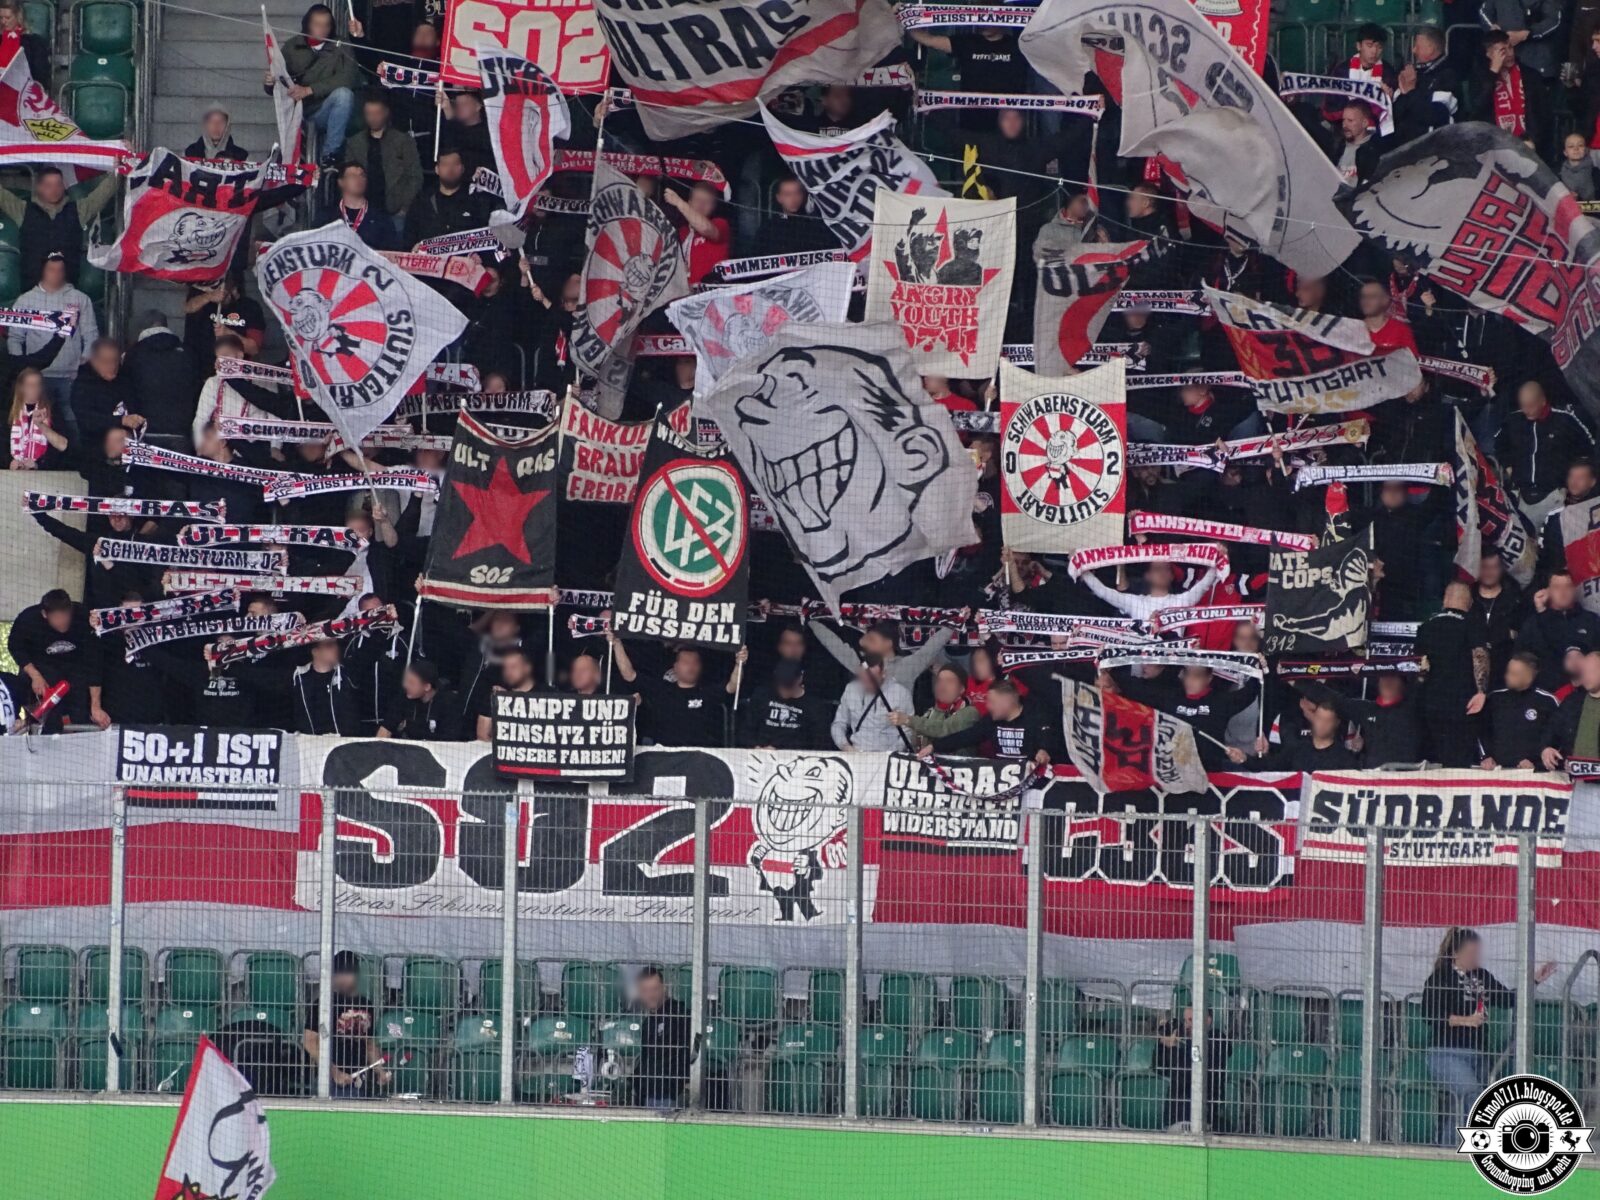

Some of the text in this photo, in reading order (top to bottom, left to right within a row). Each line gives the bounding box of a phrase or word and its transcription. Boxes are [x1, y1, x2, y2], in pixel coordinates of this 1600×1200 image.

[1007, 395, 1119, 445] SCHWABENSTURM
[1106, 450, 1120, 476] 2
[304, 480, 347, 492] HEISST
[1015, 488, 1110, 524] STUTTGART
[1133, 515, 1243, 538] CANNSTATTER
[100, 539, 250, 567] SCHWABENSTURM
[1071, 544, 1170, 570] CANNSTATTER
[1282, 566, 1334, 590] COPS
[628, 589, 678, 620] FÜR
[686, 601, 736, 624] DEN
[613, 611, 742, 645] FUSSBALL
[496, 695, 630, 722] KAMPF UND
[496, 720, 629, 746] EINSATZ FÜR
[216, 733, 279, 766] IST
[496, 746, 626, 765] UNSERE FARBEN!
[120, 763, 277, 785] UNANTASTBAR!
[1308, 789, 1570, 839] SÜDBANDE
[883, 814, 1019, 841] WIDERSTAND
[1389, 841, 1496, 860] STUTTGART
